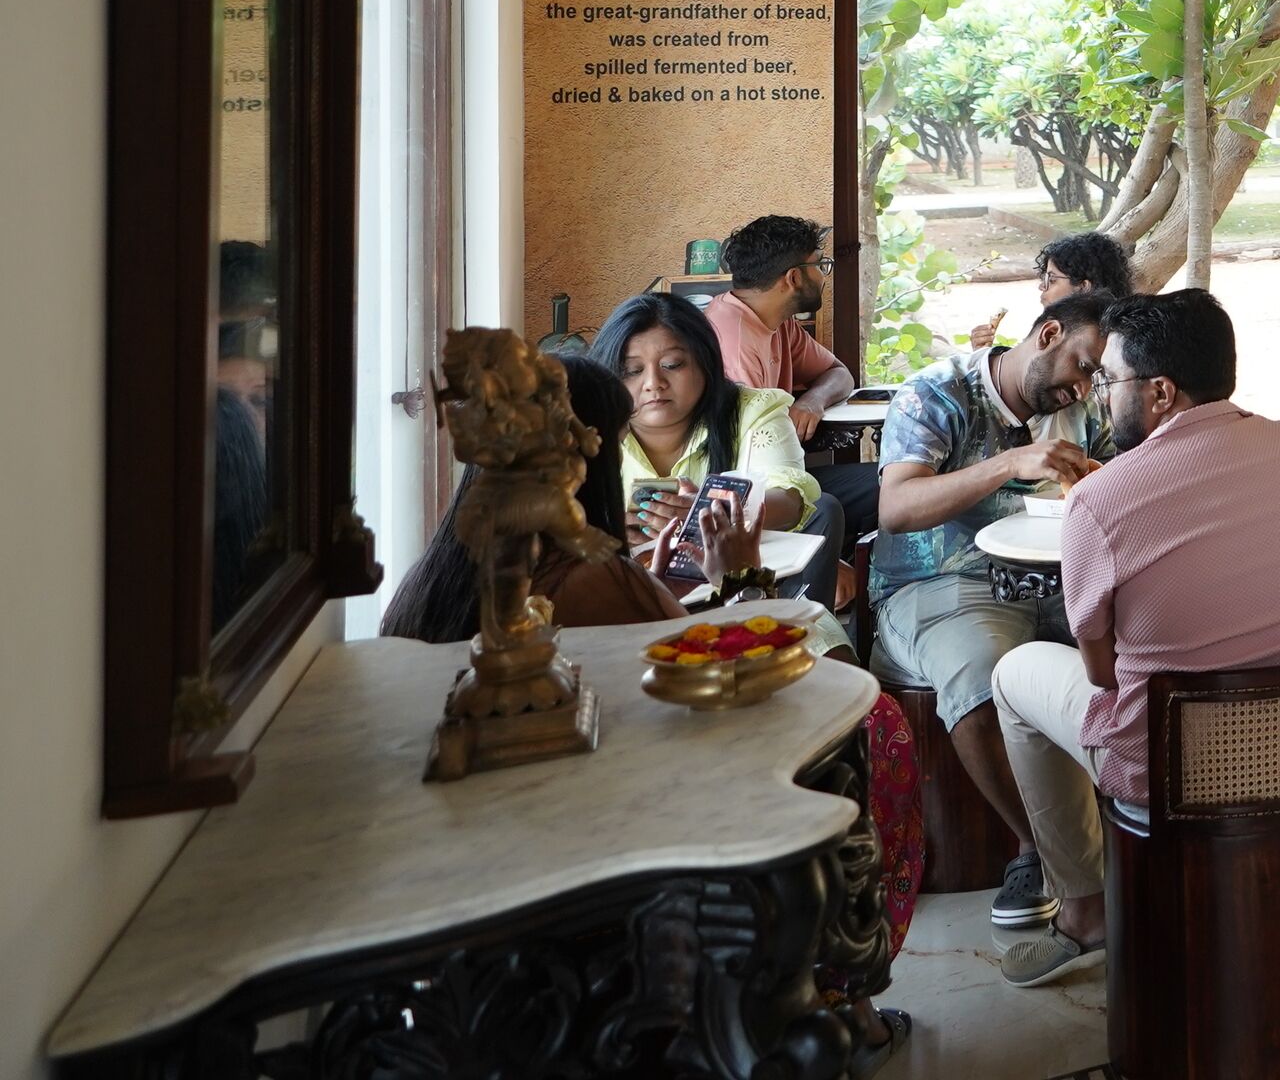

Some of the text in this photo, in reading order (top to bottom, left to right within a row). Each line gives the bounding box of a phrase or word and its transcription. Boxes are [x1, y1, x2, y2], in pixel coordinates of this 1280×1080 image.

[545, 2, 831, 23] the great-grandfather of bread,
[609, 31, 769, 47] was created from
[584, 58, 797, 79] spilled fermented beer,
[552, 85, 825, 104] dried & baked on a hot stone.
